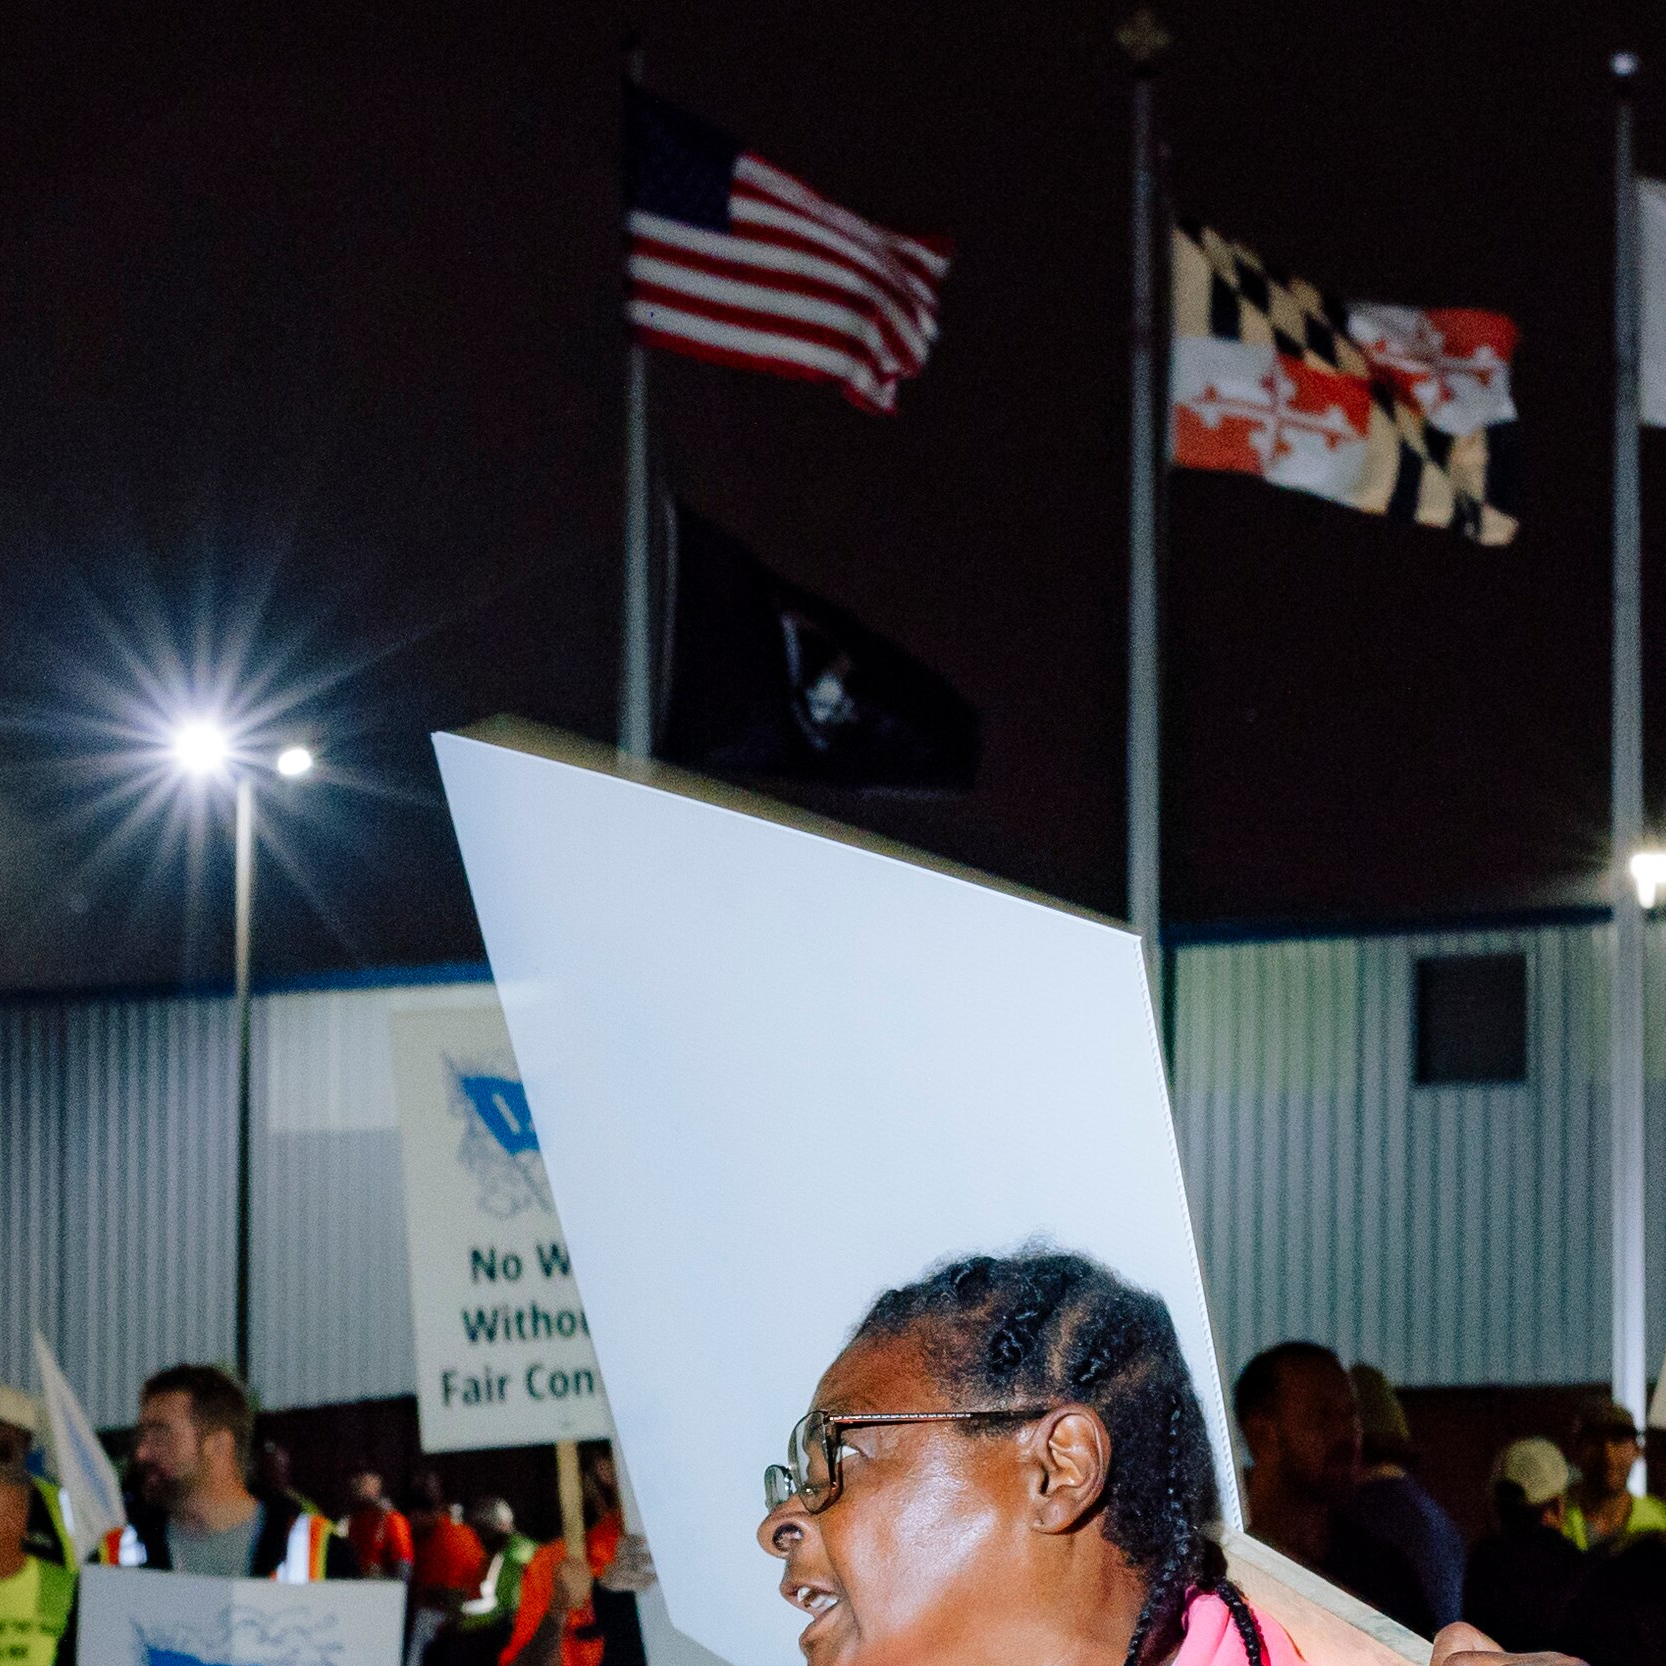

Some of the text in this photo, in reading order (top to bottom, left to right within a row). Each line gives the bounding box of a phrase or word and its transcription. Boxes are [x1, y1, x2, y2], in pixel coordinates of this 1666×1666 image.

[470, 1246, 524, 1285] No
[462, 1300, 590, 1344] Witho
[441, 1366, 511, 1409] Fair
